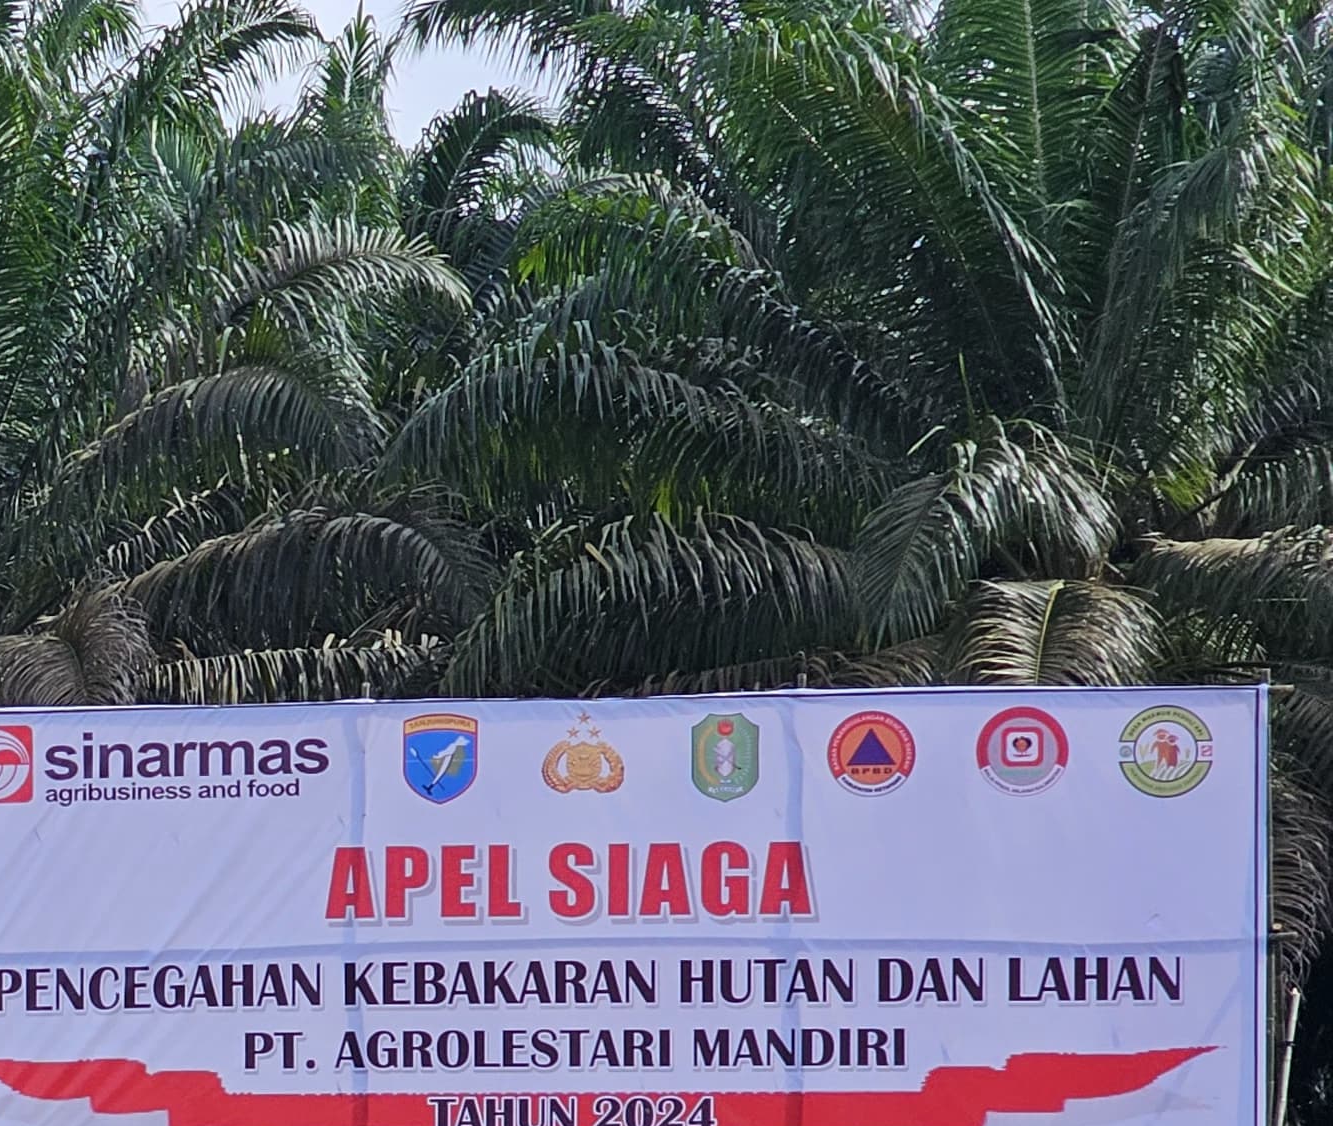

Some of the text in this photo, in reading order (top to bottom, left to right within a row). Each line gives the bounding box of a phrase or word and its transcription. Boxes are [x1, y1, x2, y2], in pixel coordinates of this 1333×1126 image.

[44, 732, 330, 781] sinarmas
[45, 778, 300, 806] agribusiness and food
[325, 840, 811, 919] APEL SIAGA
[344, 960, 656, 1006] KEBAKARAN
[680, 958, 854, 1004] HUTAN
[878, 957, 984, 1003] DAN
[1008, 956, 1181, 1002] LAHAN
[244, 1028, 906, 1070] PT. AGROLESTARI MANDIRI
